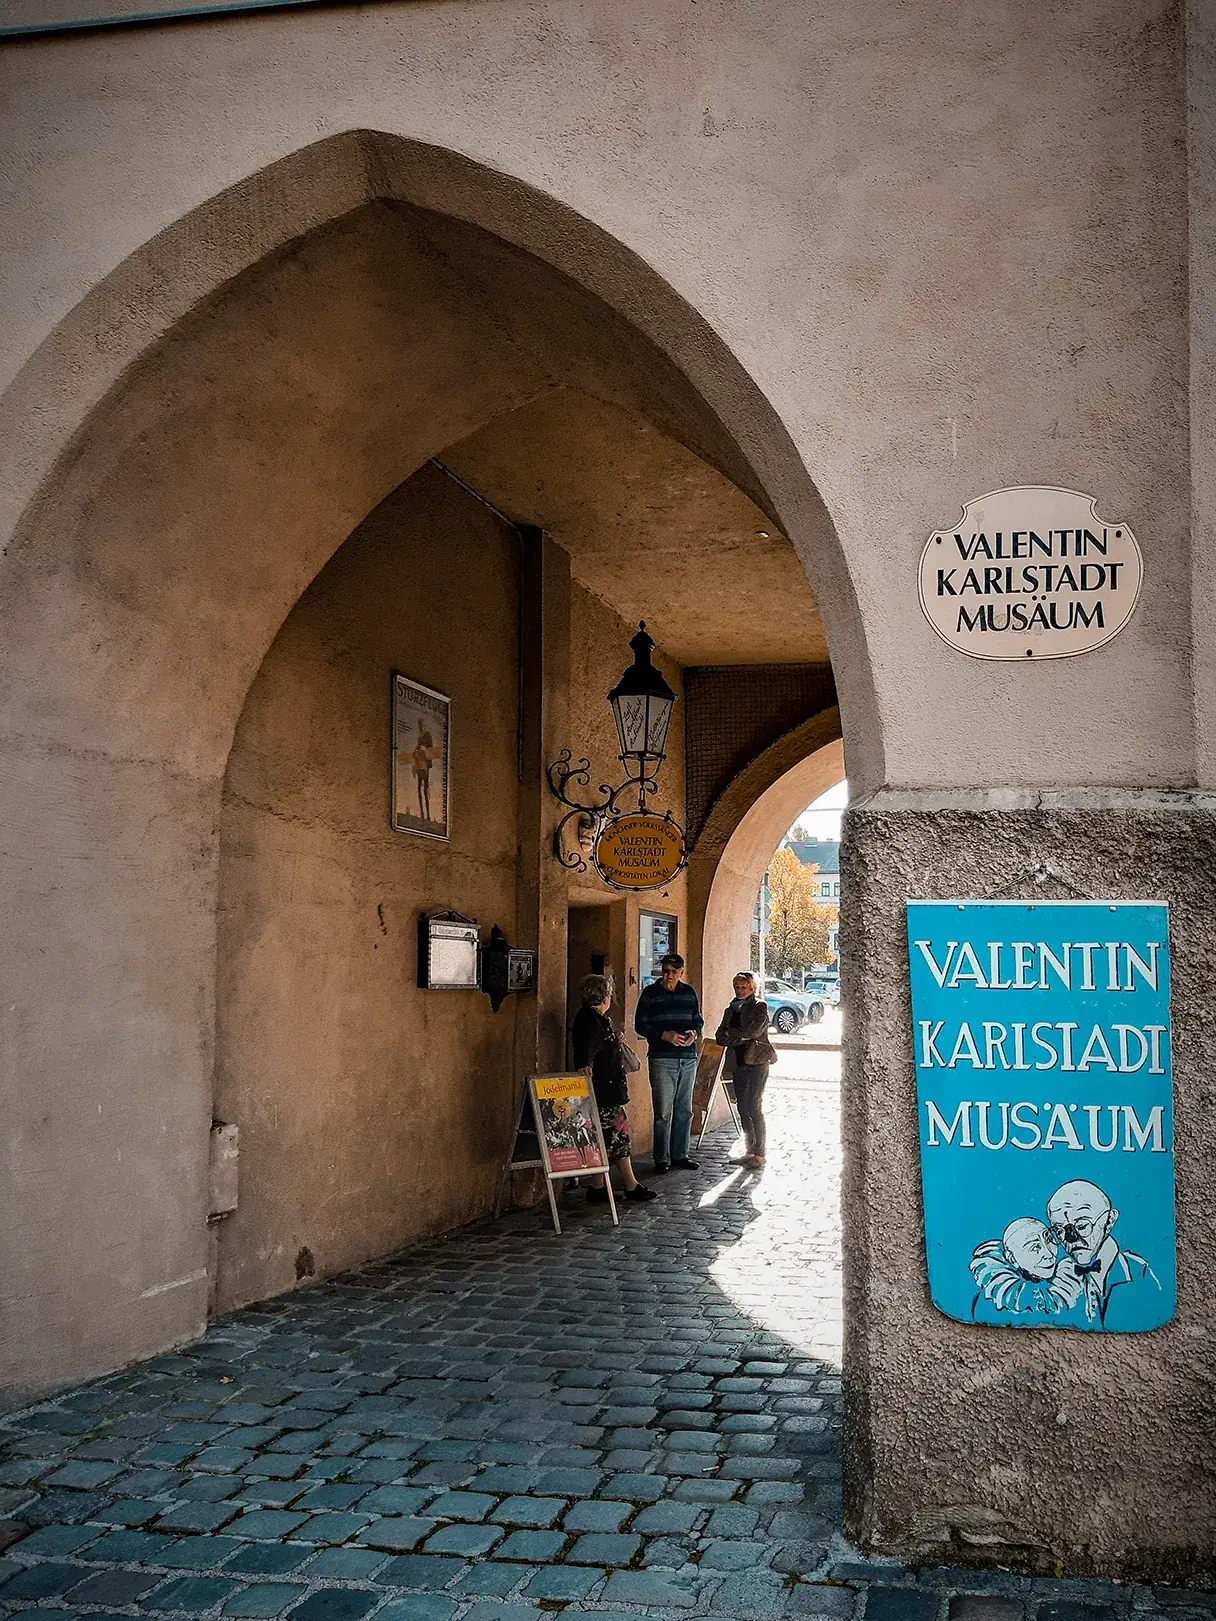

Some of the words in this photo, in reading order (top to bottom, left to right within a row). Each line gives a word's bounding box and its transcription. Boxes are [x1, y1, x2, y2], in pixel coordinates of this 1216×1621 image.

[953, 528, 1107, 561] VALENTIN
[936, 562, 1124, 597] KARLSTADT
[956, 594, 1105, 633] MUSÄUM
[613, 847, 666, 857] KARLSTADT
[619, 836, 663, 846] VALENTIN
[618, 855, 660, 867] MUSÄUM
[914, 940, 1162, 992] VALENTIN
[918, 1020, 1168, 1075] KARLSTADT
[924, 1101, 1167, 1153] MUSÄUM
